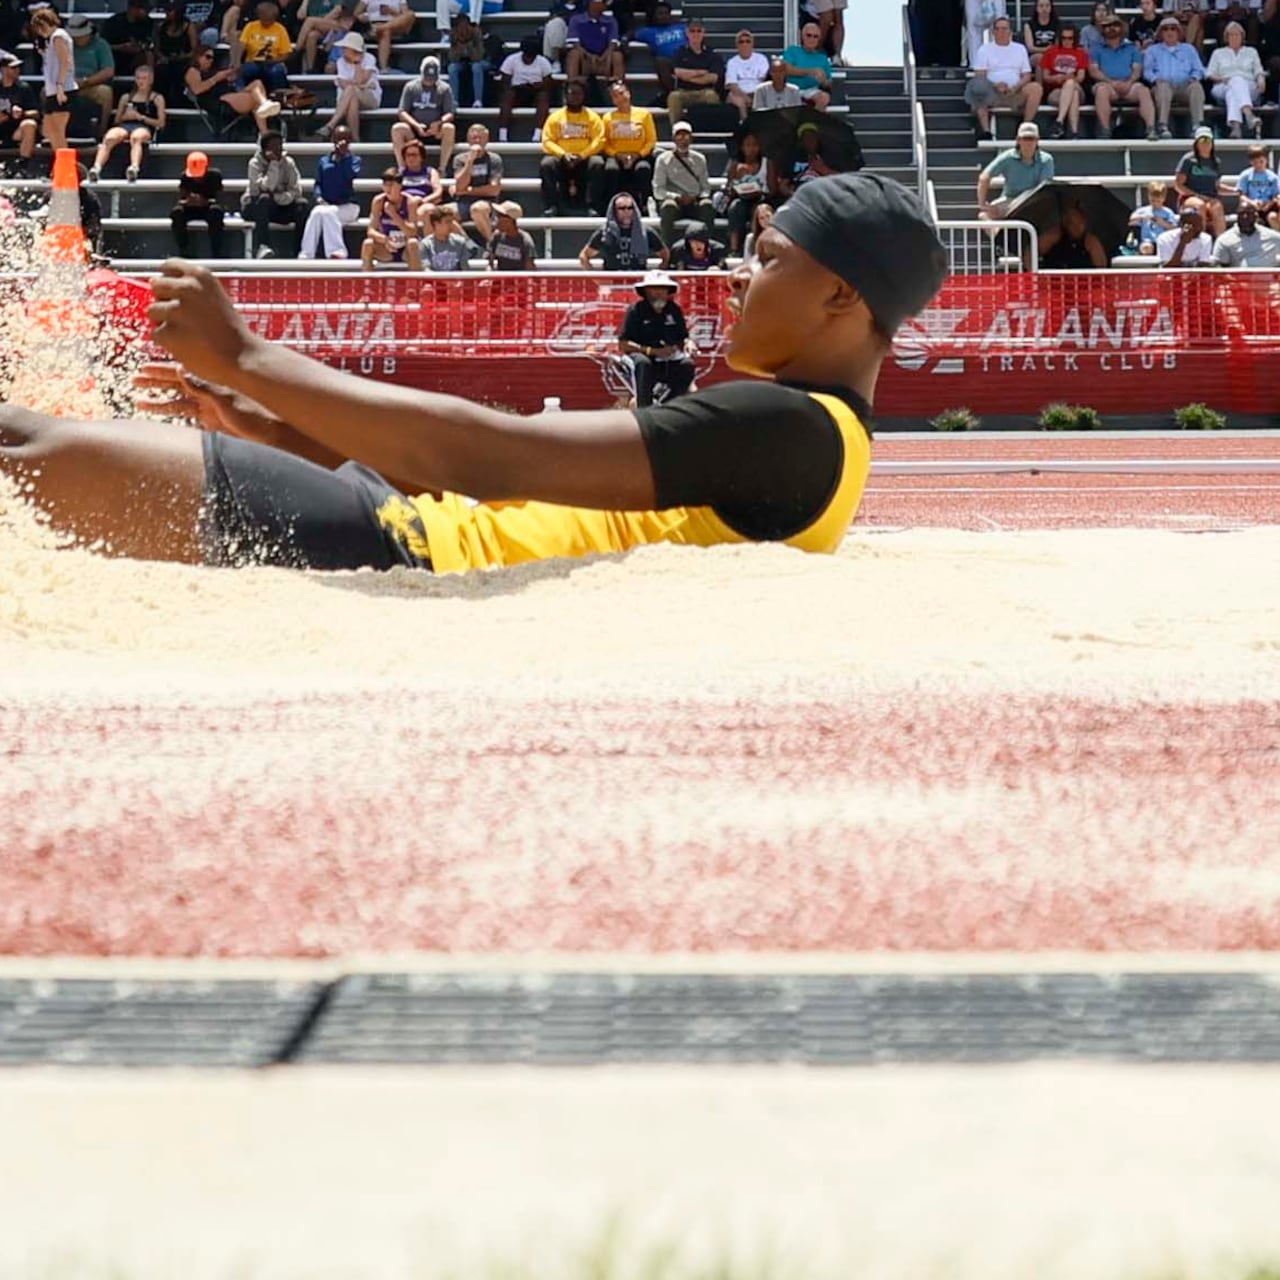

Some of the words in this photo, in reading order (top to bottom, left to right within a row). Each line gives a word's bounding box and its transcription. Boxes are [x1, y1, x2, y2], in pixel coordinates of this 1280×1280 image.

[979, 306, 1177, 350] ATLANTA
[321, 356, 397, 374] LUB
[981, 353, 1079, 371] TRACK
[1099, 352, 1177, 370] CLUB
